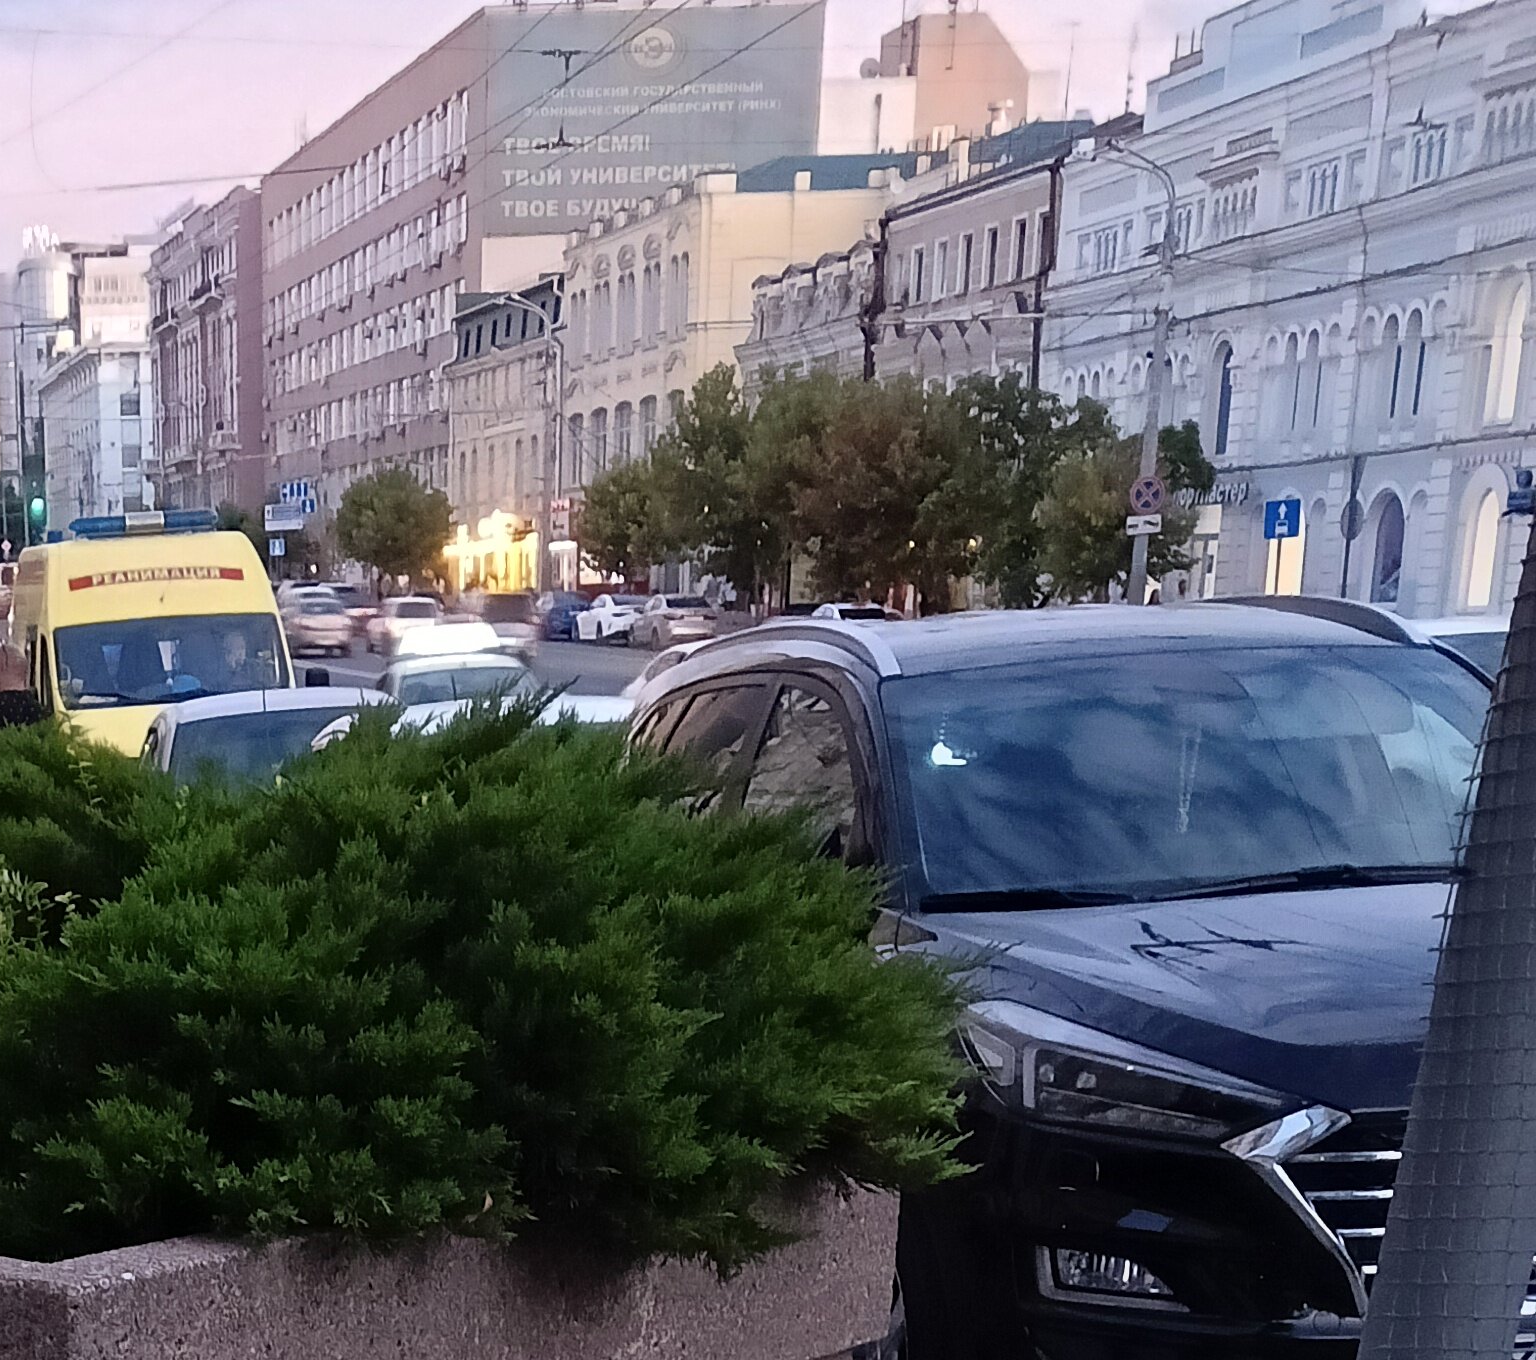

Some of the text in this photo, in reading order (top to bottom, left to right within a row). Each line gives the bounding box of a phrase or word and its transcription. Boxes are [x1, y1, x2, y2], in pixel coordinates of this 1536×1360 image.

[502, 164, 562, 187] ТВОЙ
[500, 200, 559, 218] ТВОЕ
[92, 566, 222, 587] РЕАНИМАЦИЯ
